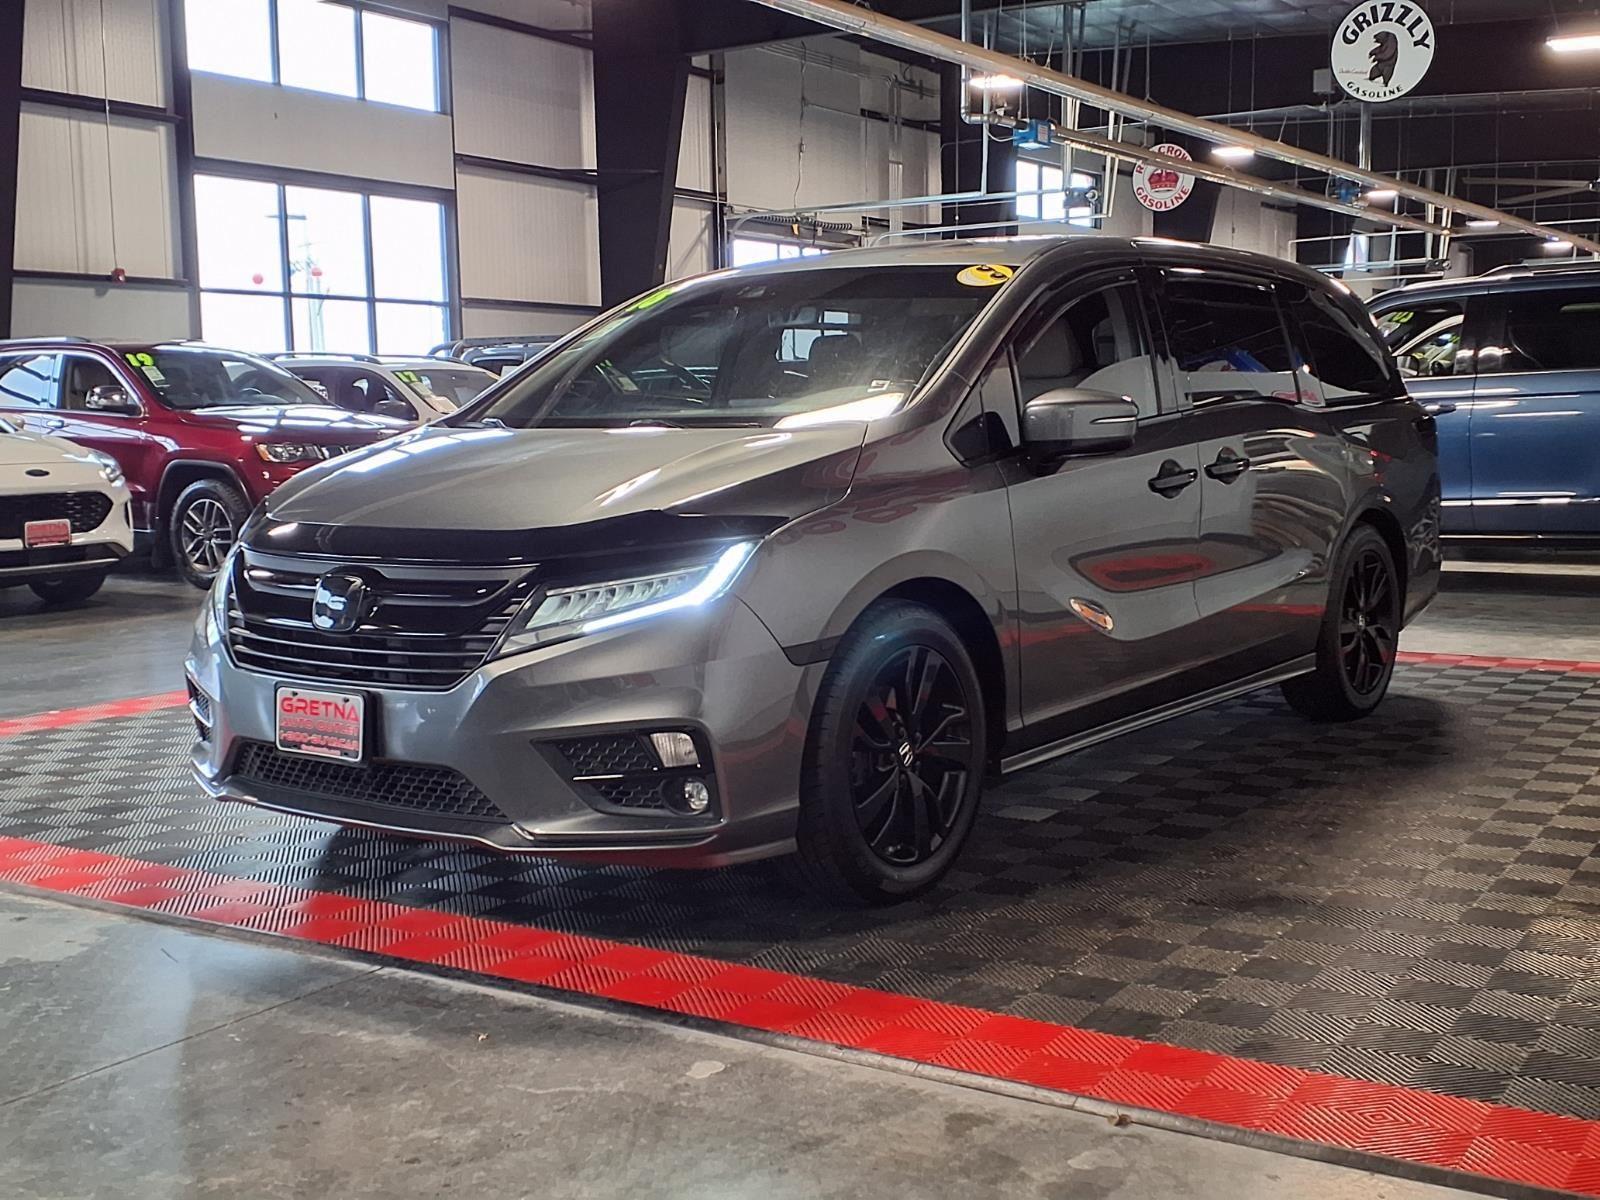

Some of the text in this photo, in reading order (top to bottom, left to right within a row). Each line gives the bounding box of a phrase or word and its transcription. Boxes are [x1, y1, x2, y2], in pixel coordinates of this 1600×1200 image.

[1342, 2, 1431, 49] GRIZZLY
[1346, 81, 1404, 98] GASOLINE
[1136, 186, 1190, 209] GASOLINE
[125, 352, 154, 367] 19
[281, 697, 360, 722] GRETNA
